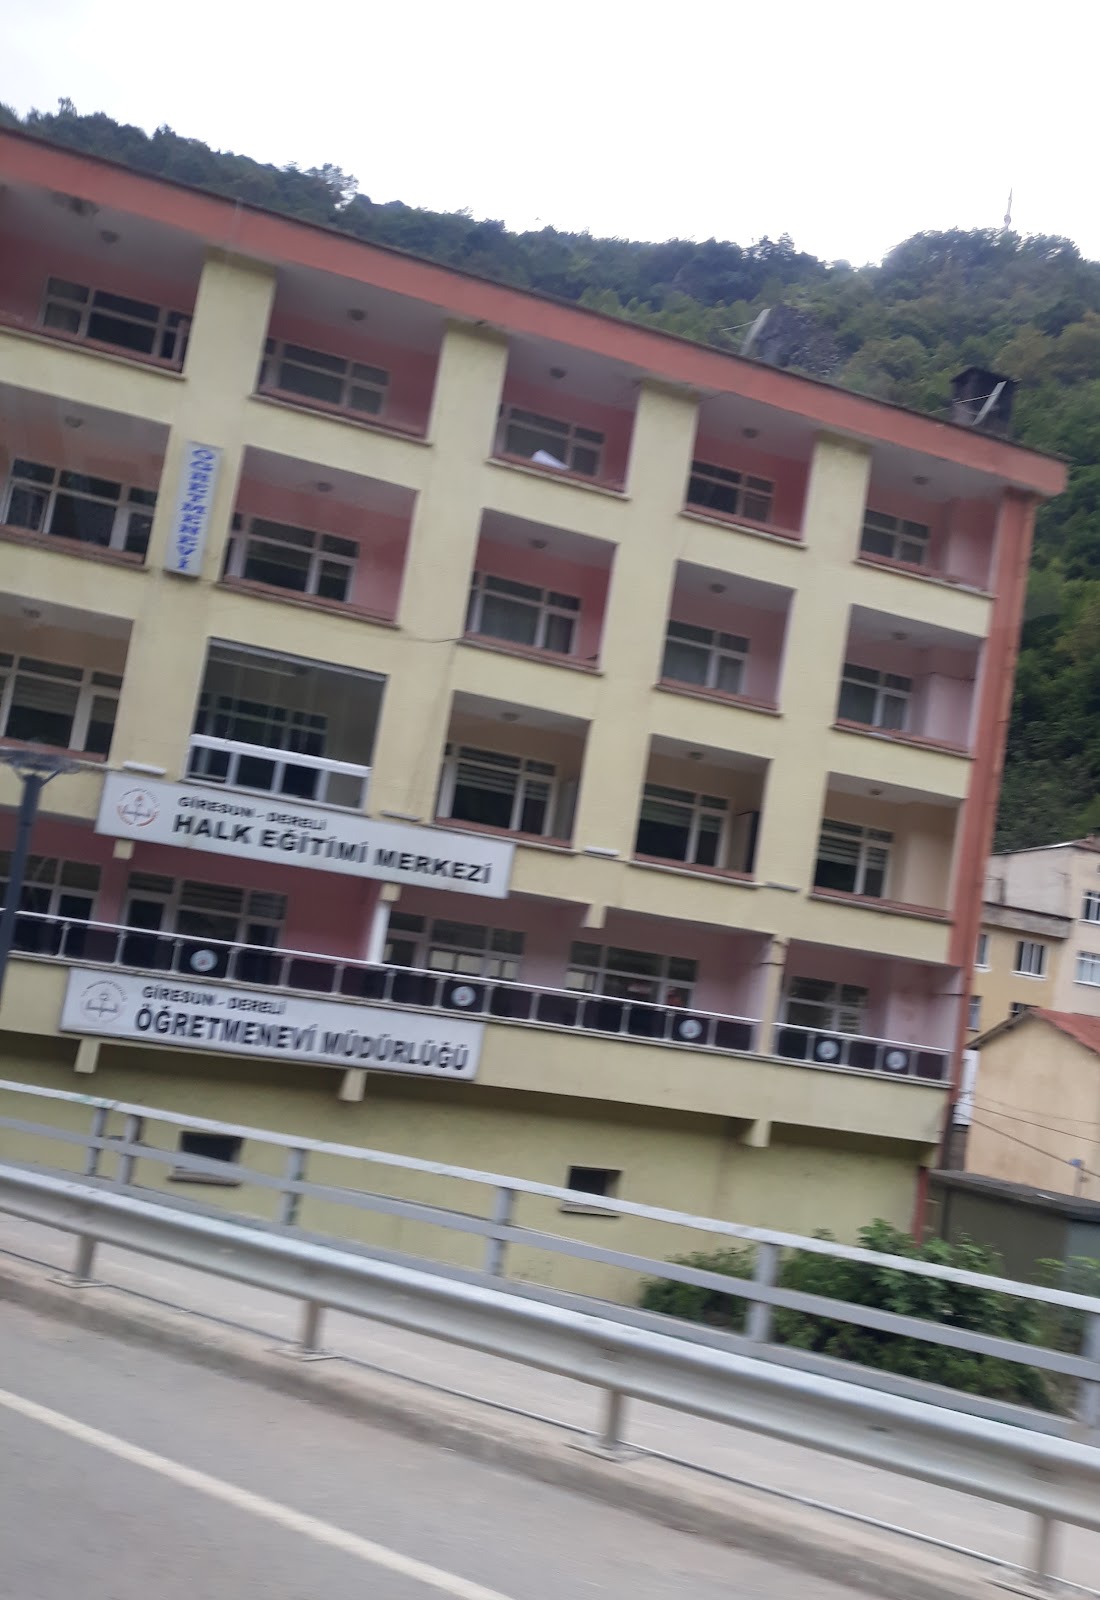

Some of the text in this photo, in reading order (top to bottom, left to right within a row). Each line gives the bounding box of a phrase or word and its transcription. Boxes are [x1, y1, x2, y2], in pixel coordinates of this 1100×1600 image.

[178, 795, 256, 818] GİRESUN
[265, 812, 328, 830] DERELİ
[173, 814, 493, 884] HALK EĞİTİMİ MERKEZİ
[142, 984, 217, 1006] GİRESUN
[135, 1003, 318, 1052] ÖĞRETMENEVİ
[320, 1029, 469, 1070] MÜDÜRLÜĞÜ
